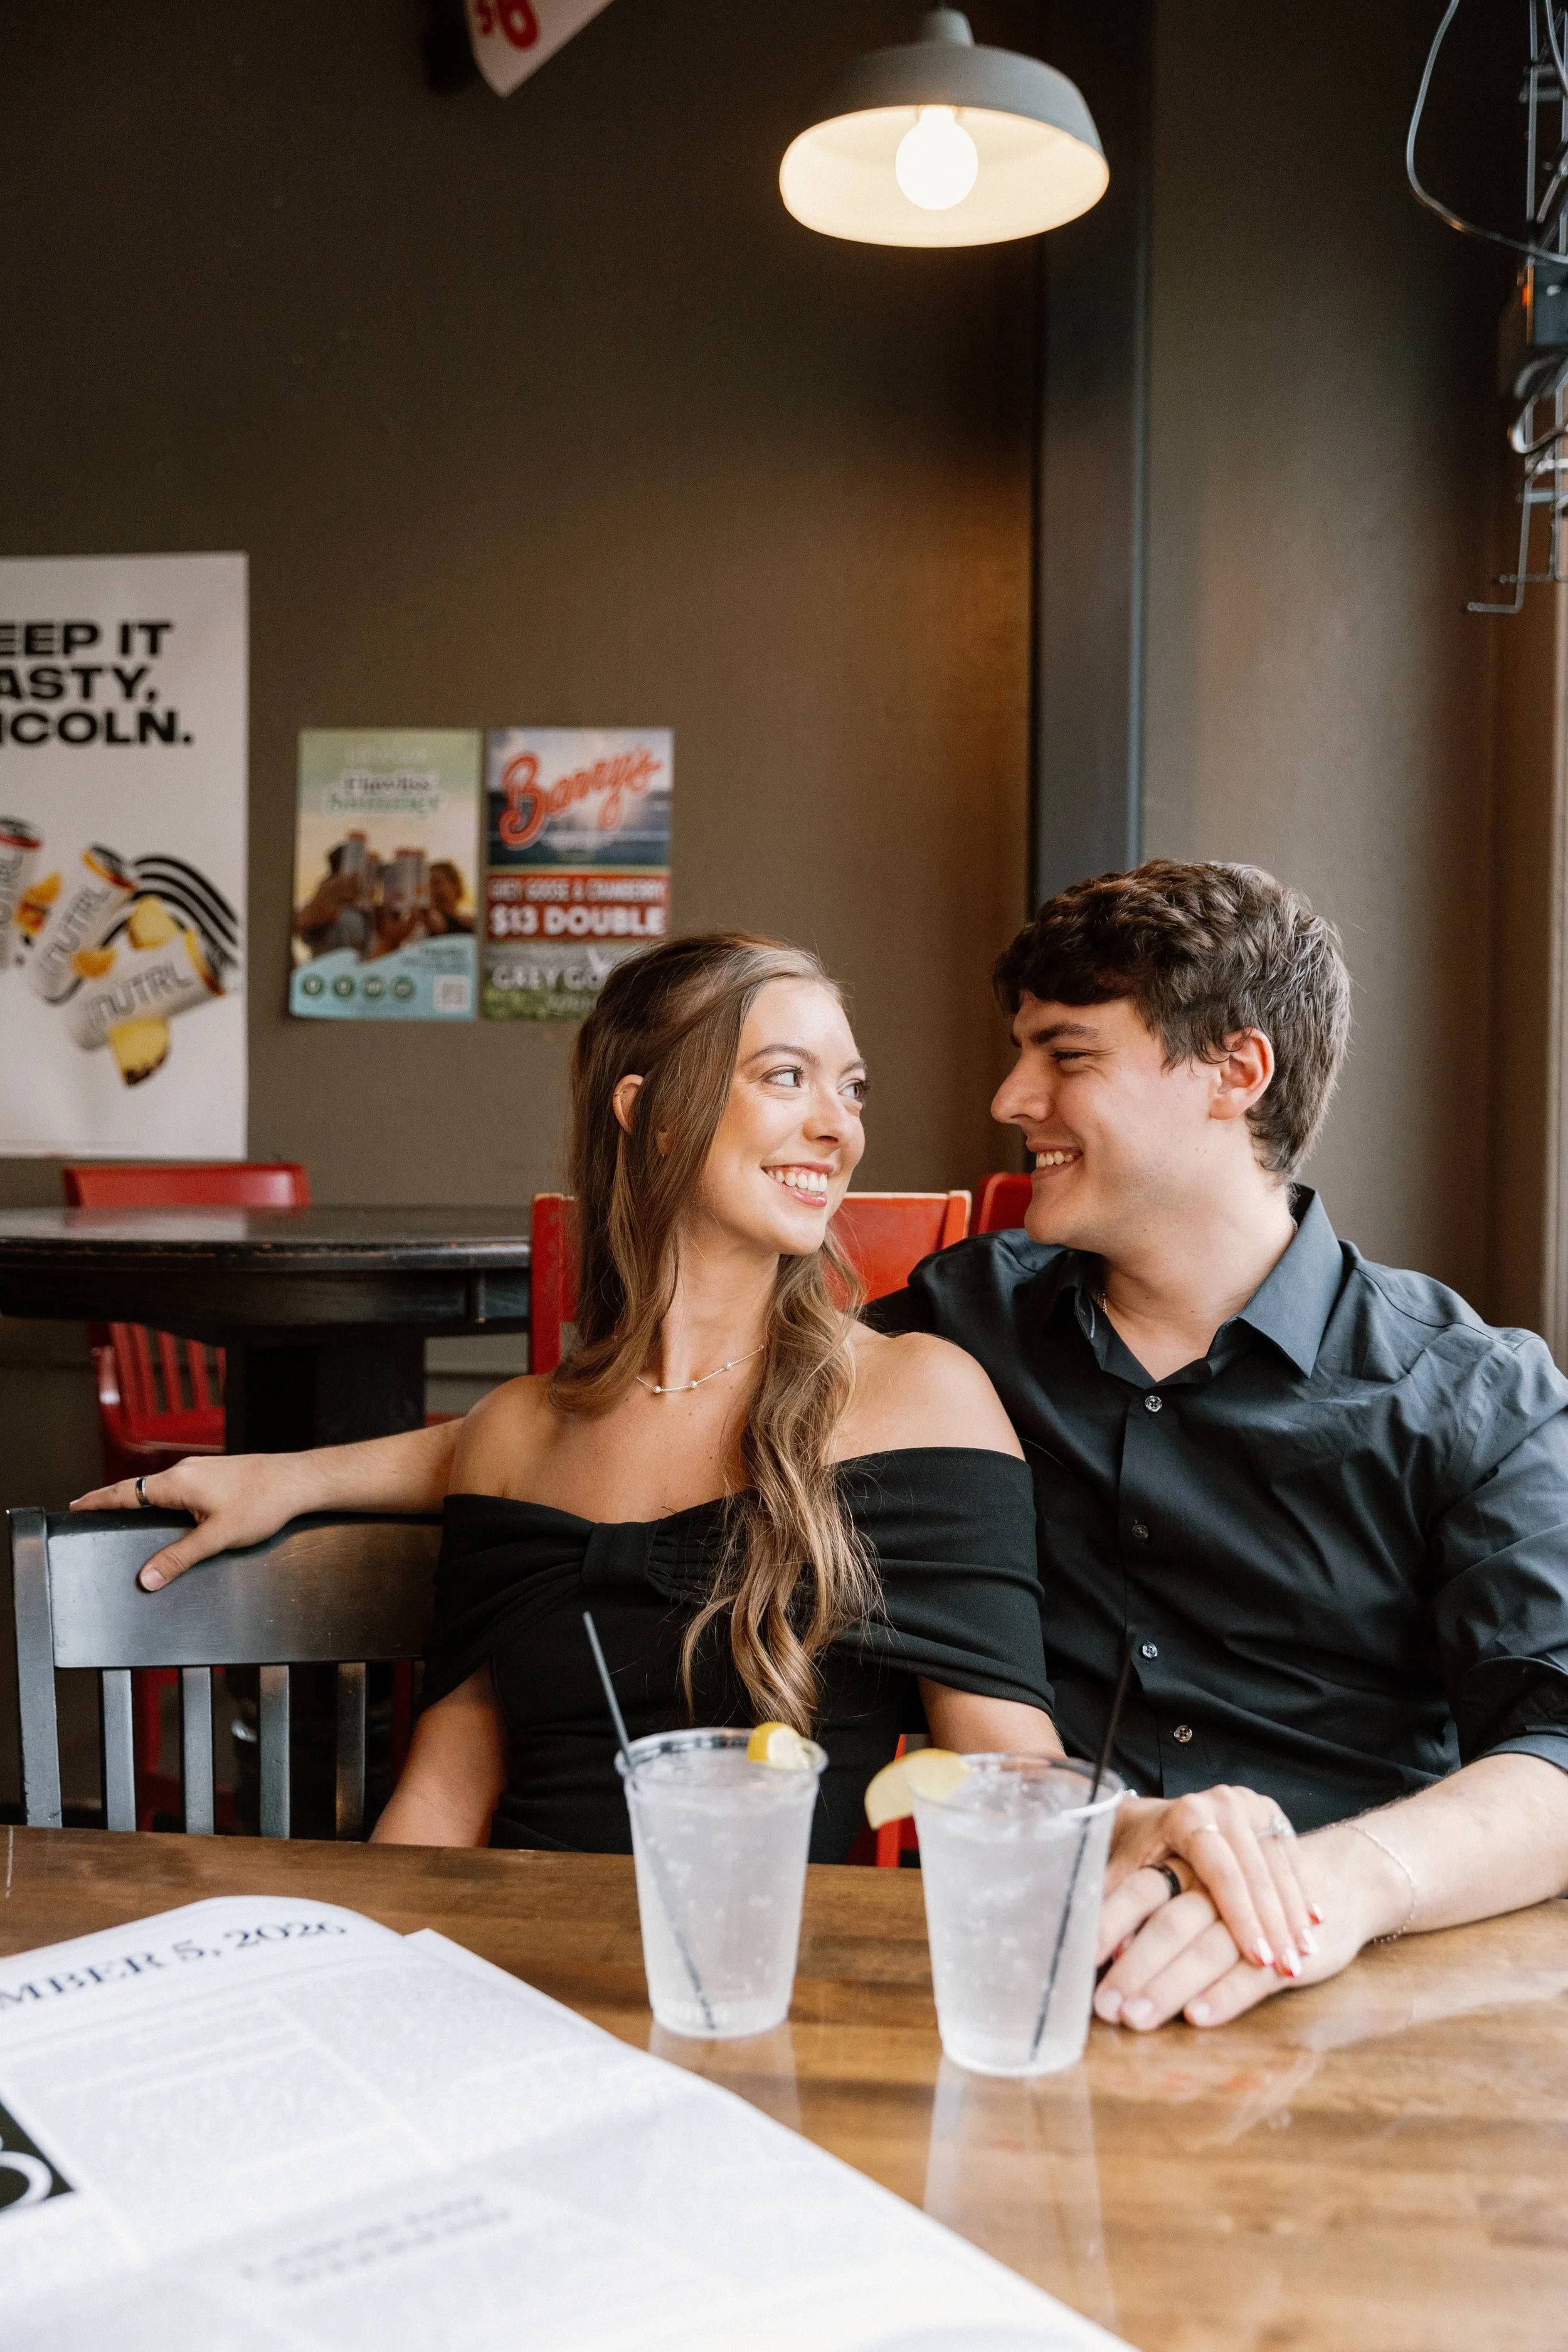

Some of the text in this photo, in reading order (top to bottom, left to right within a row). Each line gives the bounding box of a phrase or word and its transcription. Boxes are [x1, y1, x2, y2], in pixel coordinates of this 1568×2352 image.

[120, 622, 172, 655] IT
[0, 711, 193, 745] COLN.
[543, 905, 666, 936] DOUBLE
